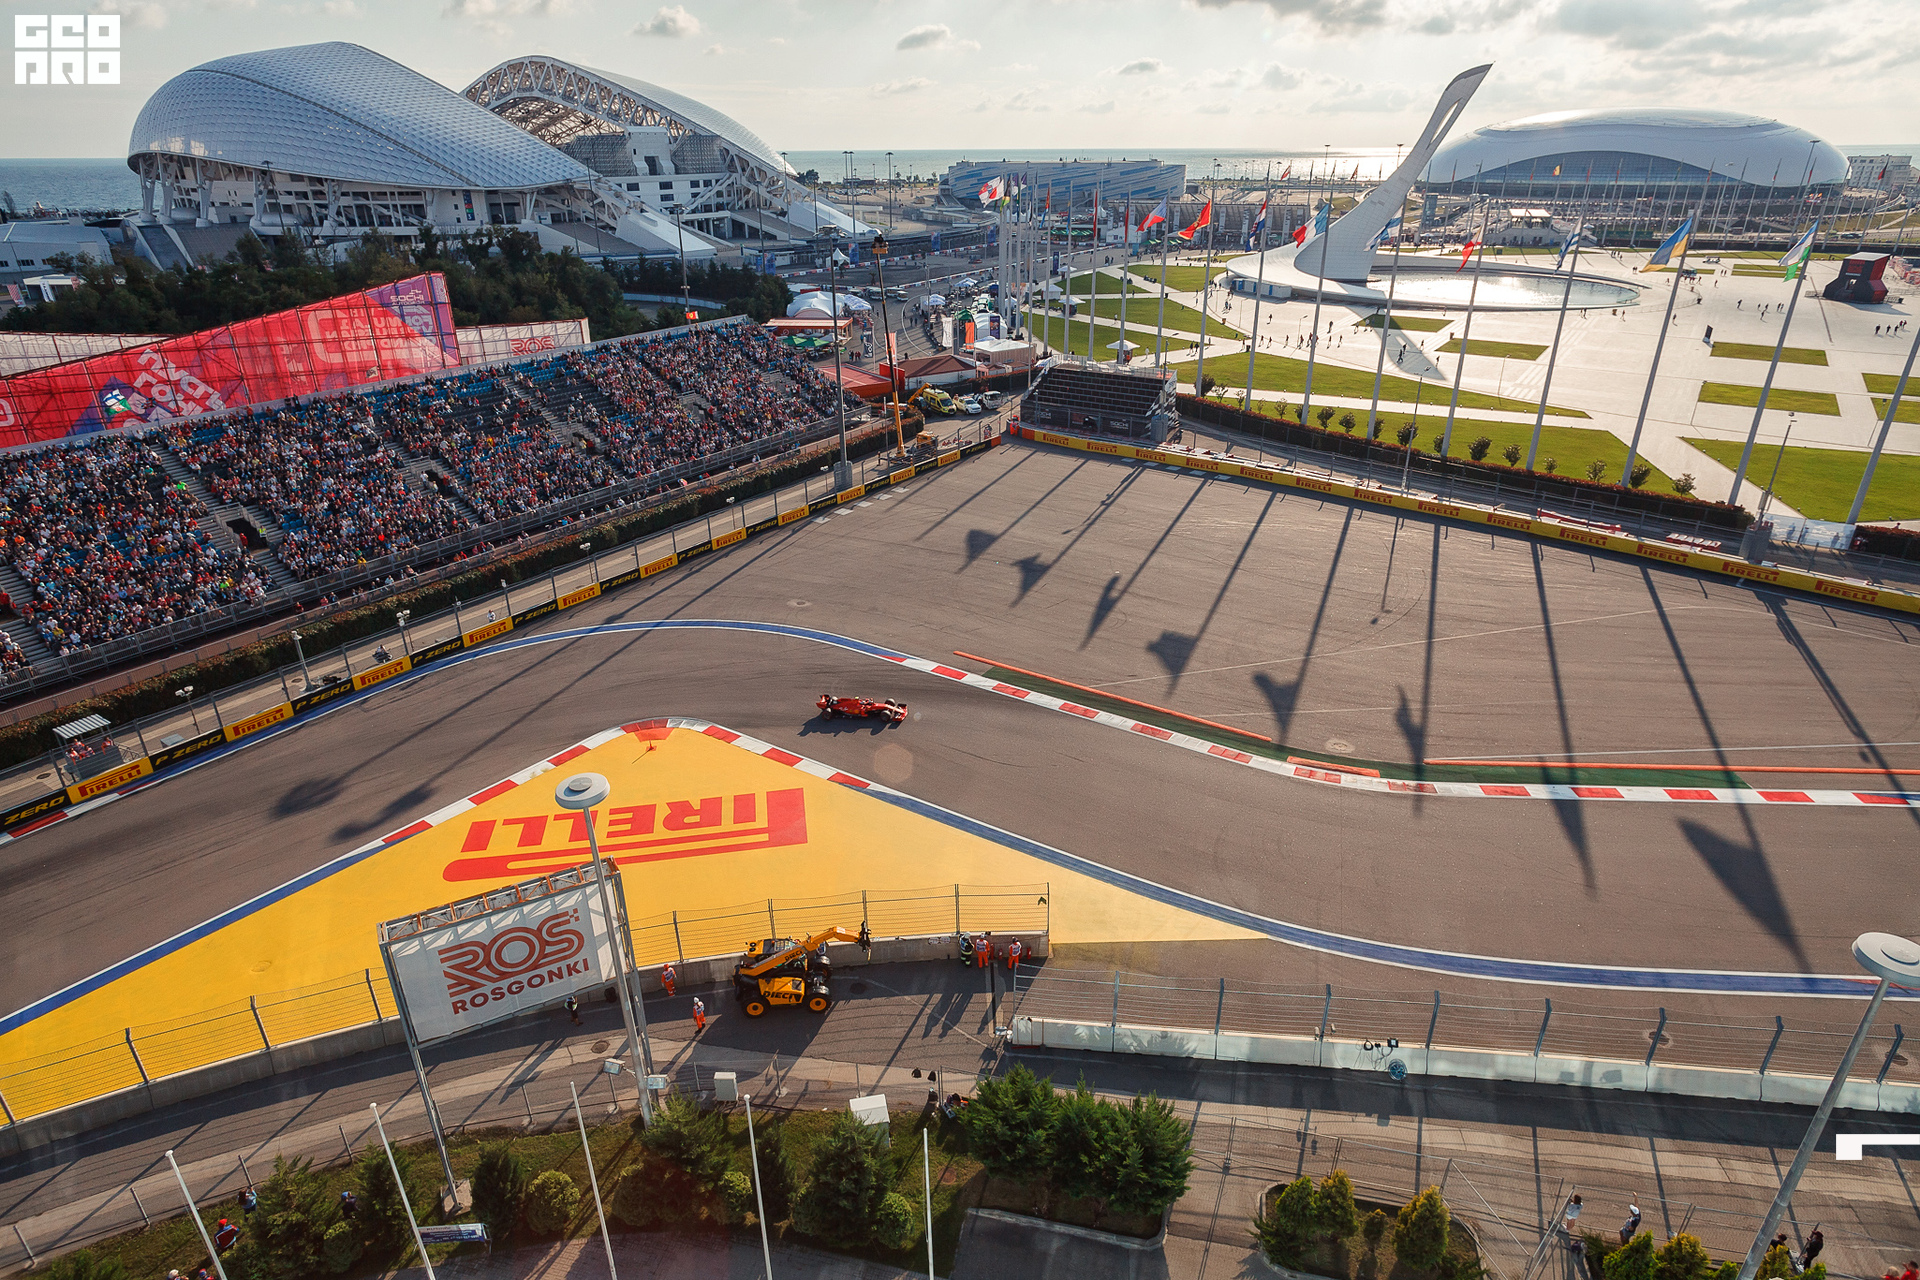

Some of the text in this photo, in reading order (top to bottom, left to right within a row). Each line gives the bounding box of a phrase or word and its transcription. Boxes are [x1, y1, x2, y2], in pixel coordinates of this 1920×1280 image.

[510, 336, 555, 356] ROS
[1043, 433, 1069, 445] PIRELLI
[1087, 442, 1117, 453] PIRELLI
[1136, 449, 1166, 462] PIRELLI
[1186, 458, 1218, 471] PIRELLI
[1240, 467, 1273, 481] PIRELLI
[872, 479, 890, 489] ZERO
[1296, 477, 1332, 492] PIRELLI
[817, 498, 837, 509] ZERO
[840, 488, 862, 502] PIRELLI
[1355, 489, 1392, 504] PIRELLI
[782, 508, 806, 523] PIRELLI
[1418, 501, 1460, 517] PIRELLI
[755, 520, 777, 531] ZERO
[1487, 514, 1531, 530] PIRELLI
[716, 531, 742, 547] PIRELLI
[1560, 528, 1607, 546] PIRELLI
[687, 544, 711, 557] ZERO
[1637, 544, 1688, 563] PIRELLI
[644, 557, 673, 575] PIRELLI
[1722, 562, 1779, 582] PIRELLI
[611, 572, 639, 587] ZERO
[562, 587, 595, 607] PIRELLI
[1815, 580, 1879, 602] PIRELLI
[514, 603, 556, 624] P ZERO
[469, 621, 507, 643] PIRELLI
[413, 641, 462, 664] P ZERO
[360, 661, 404, 686] PIRELLI
[296, 683, 351, 711] P ZERO
[232, 708, 285, 737] PIRELLI
[155, 734, 222, 766] P ZERO
[78, 764, 141, 798] PIRELLI
[4, 796, 65, 826] ZERO
[443, 788, 808, 882] PIRELLI
[438, 909, 586, 998] ROS
[451, 958, 589, 1015] ROSGONKI
